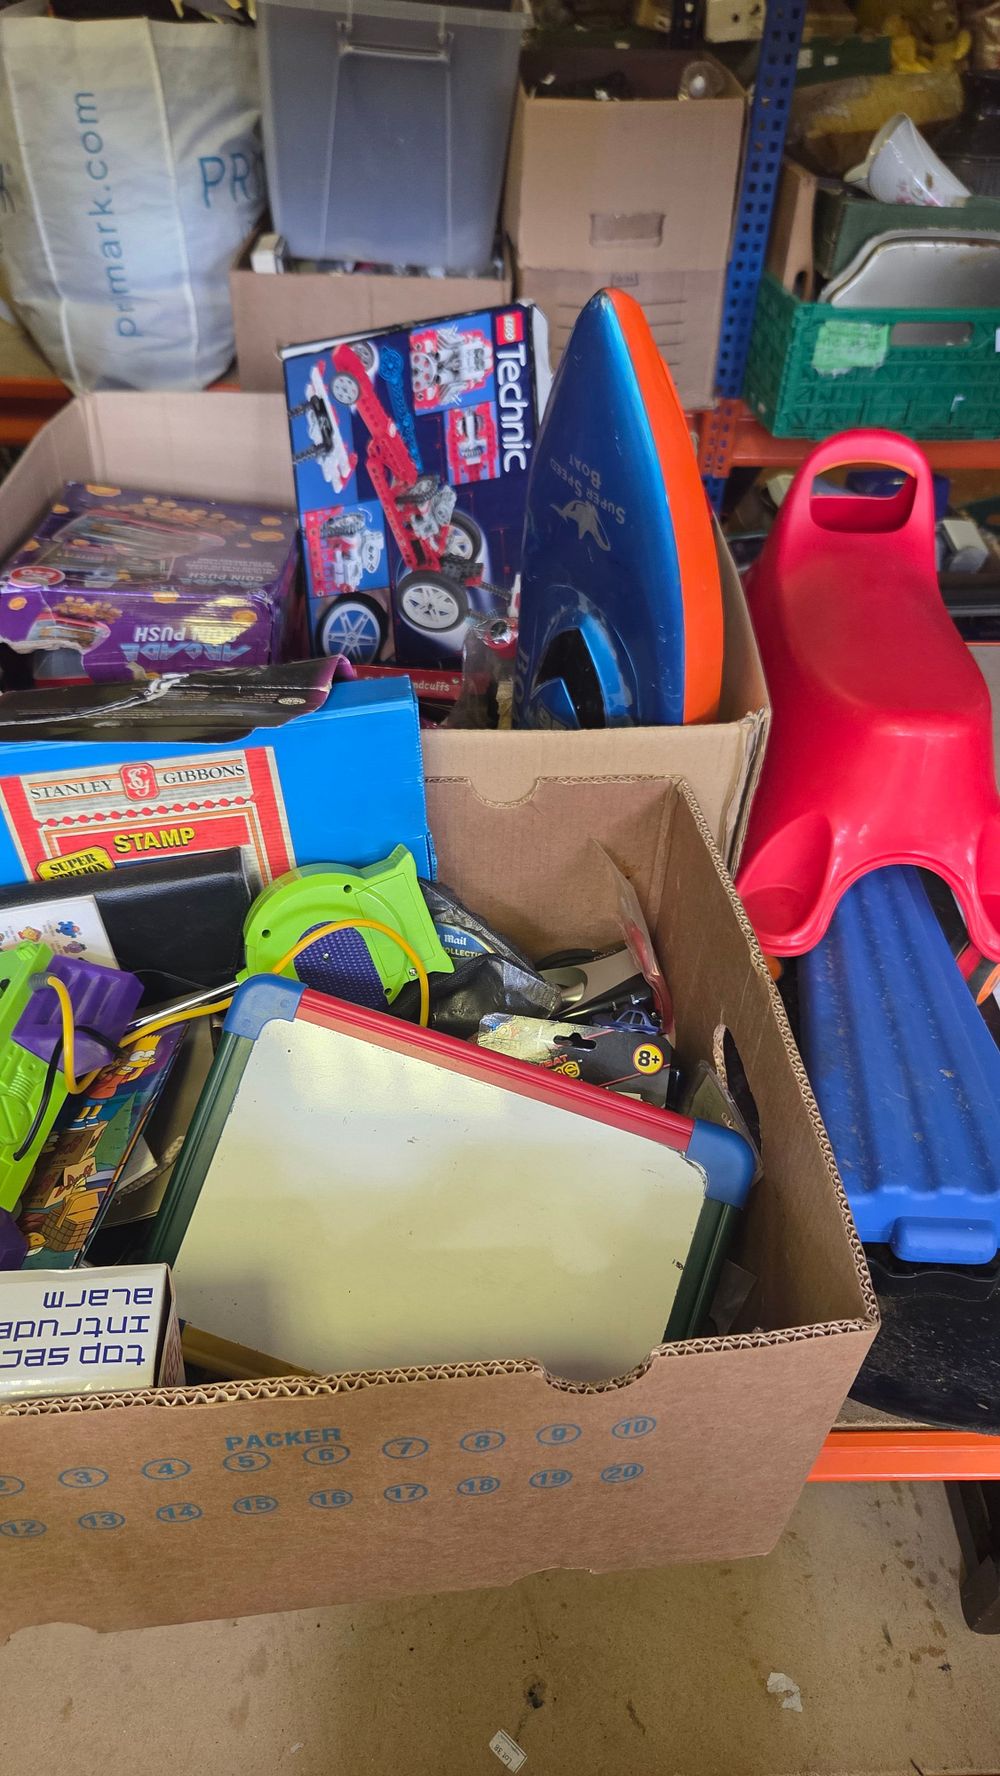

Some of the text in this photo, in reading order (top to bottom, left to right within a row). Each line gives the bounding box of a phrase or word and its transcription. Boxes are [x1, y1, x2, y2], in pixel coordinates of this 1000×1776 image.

[75, 91, 145, 338] prmark.com
[497, 344, 531, 473] Technic
[568, 454, 601, 490] BOAT
[586, 488, 626, 524] SUPER
[188, 571, 264, 582] COIN PUSH
[134, 626, 186, 642] PUSH
[120, 641, 252, 662] ARCADE
[31, 764, 245, 799] STANLEY GIBBONS
[113, 826, 196, 854] STAMP
[49, 853, 97, 875] SUPER
[50, 861, 109, 880] ITION
[444, 934, 467, 946] Mail
[638, 1050, 660, 1067] 8+
[0, 1342, 145, 1369] top sec
[621, 1420, 648, 1434] 10
[225, 1428, 341, 1450] PACKER
